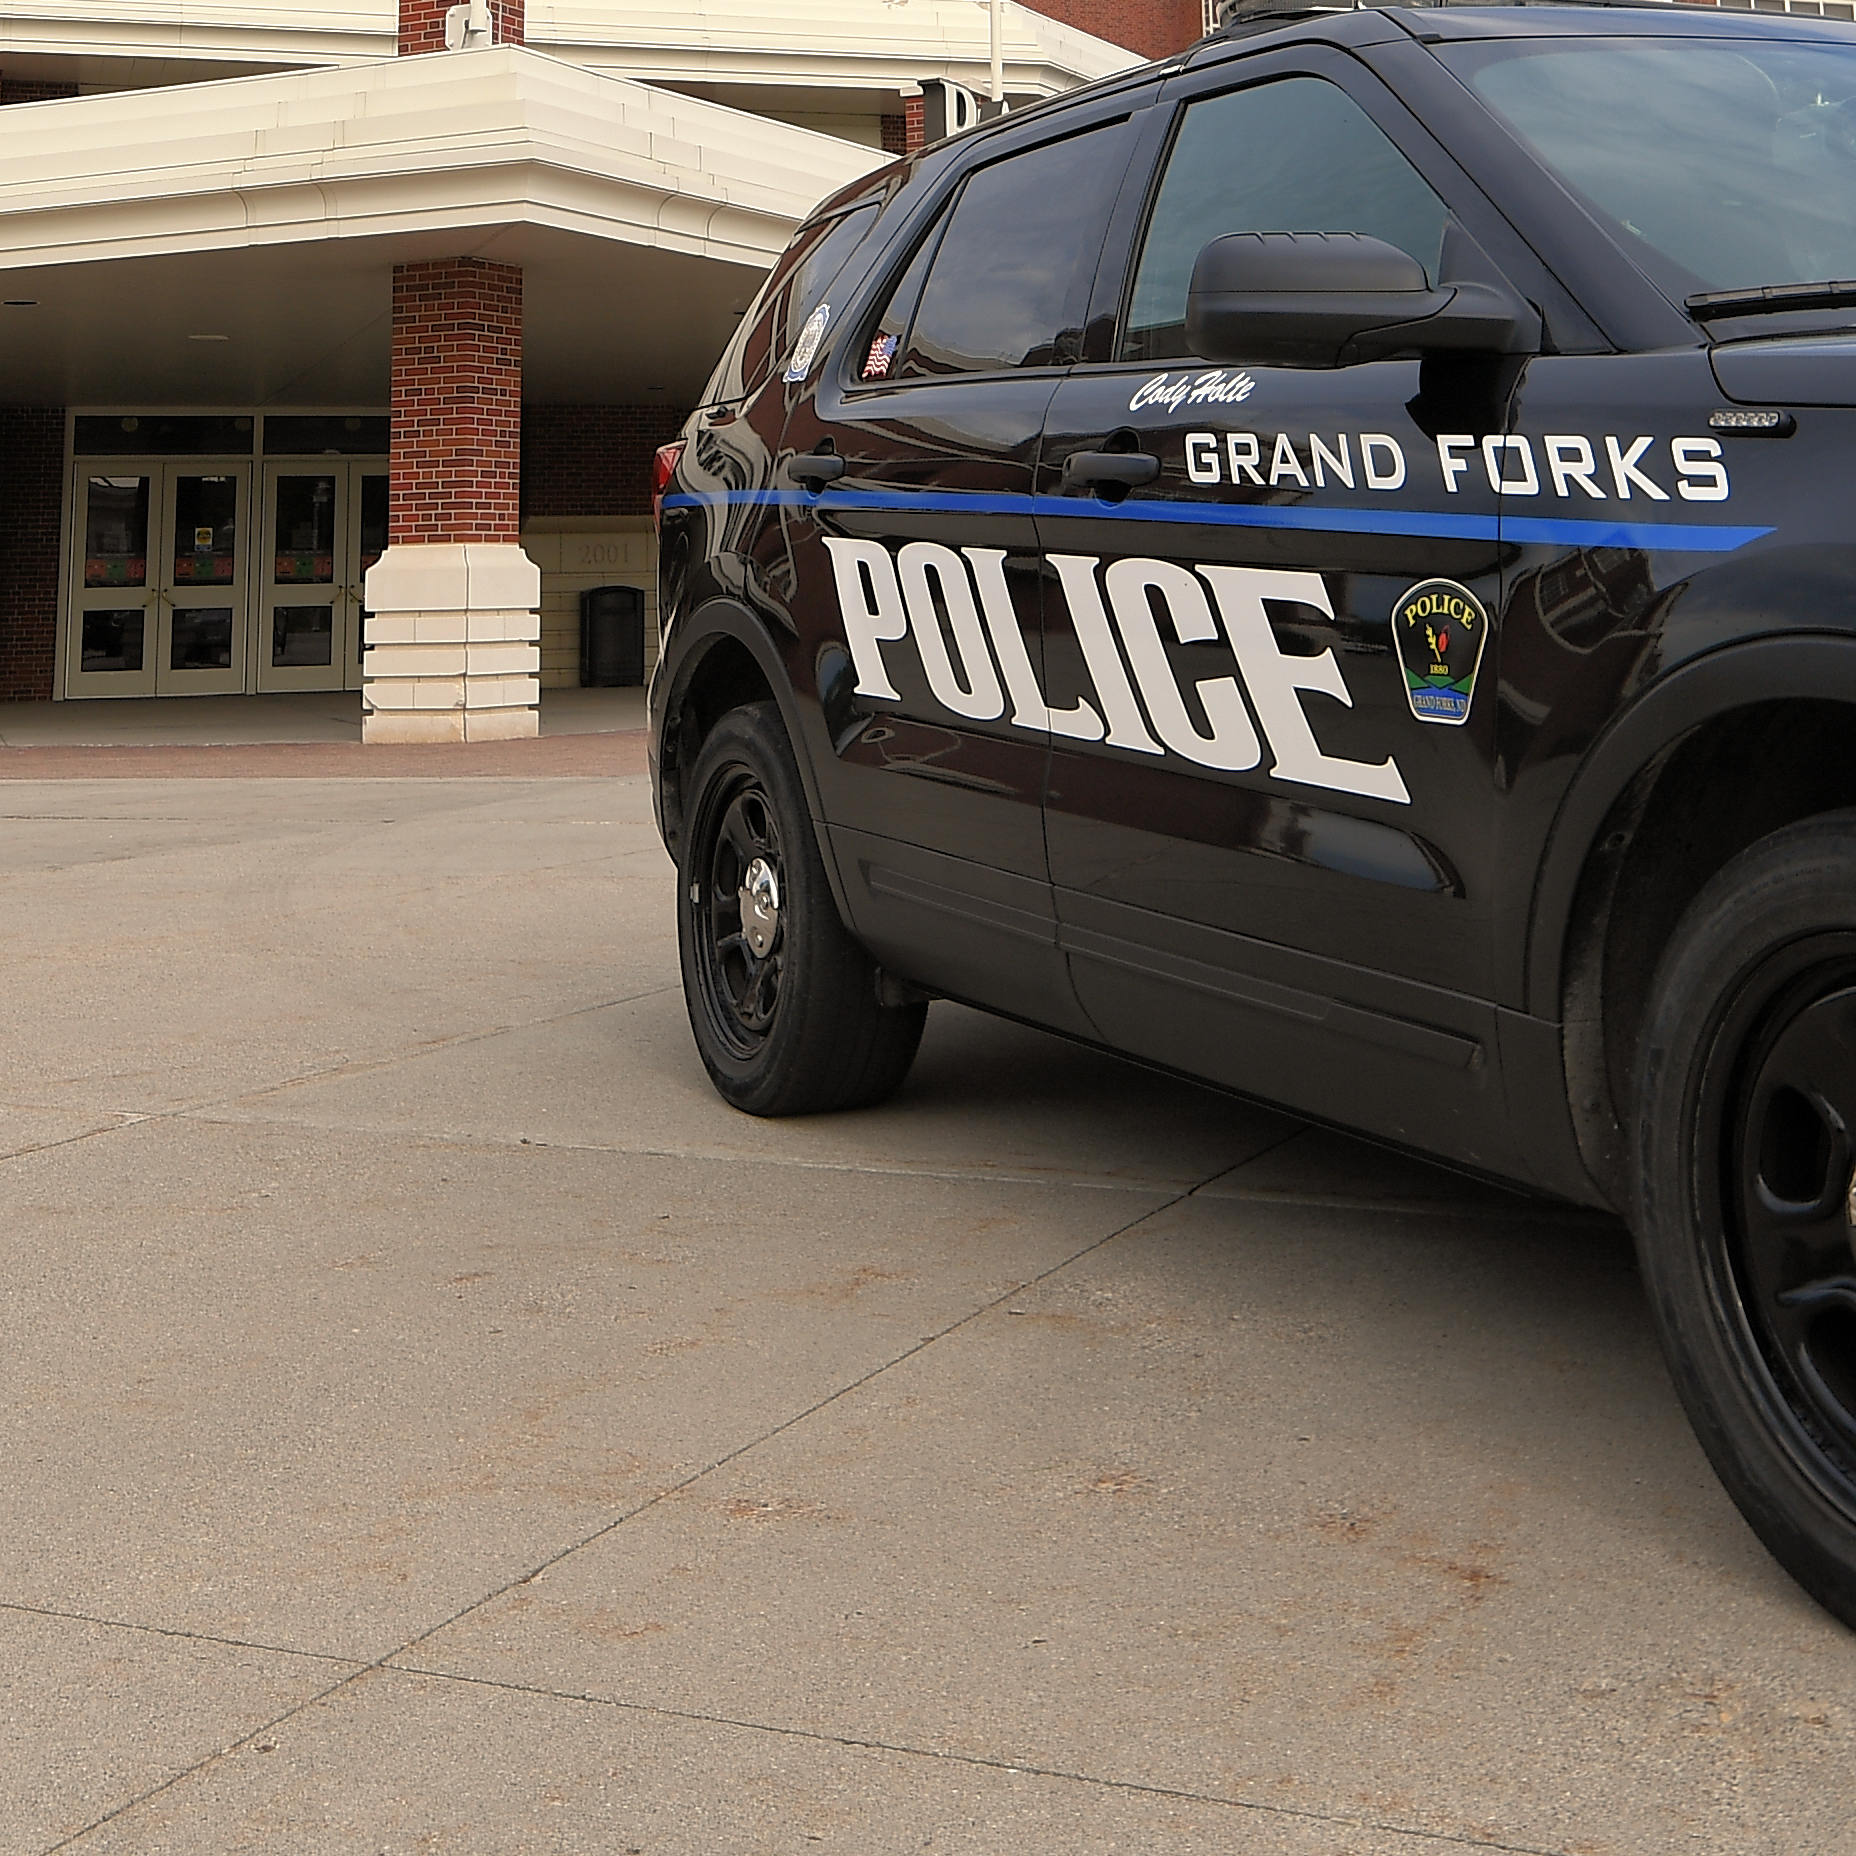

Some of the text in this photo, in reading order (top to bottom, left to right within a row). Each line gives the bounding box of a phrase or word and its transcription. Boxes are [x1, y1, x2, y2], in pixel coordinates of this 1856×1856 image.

[1129, 370, 1256, 414] Cody Holte
[1185, 432, 1730, 501] GRAND FORKS
[578, 543, 630, 565] 2001
[1404, 594, 1476, 631] POLICE
[821, 536, 1411, 804] POLICE
